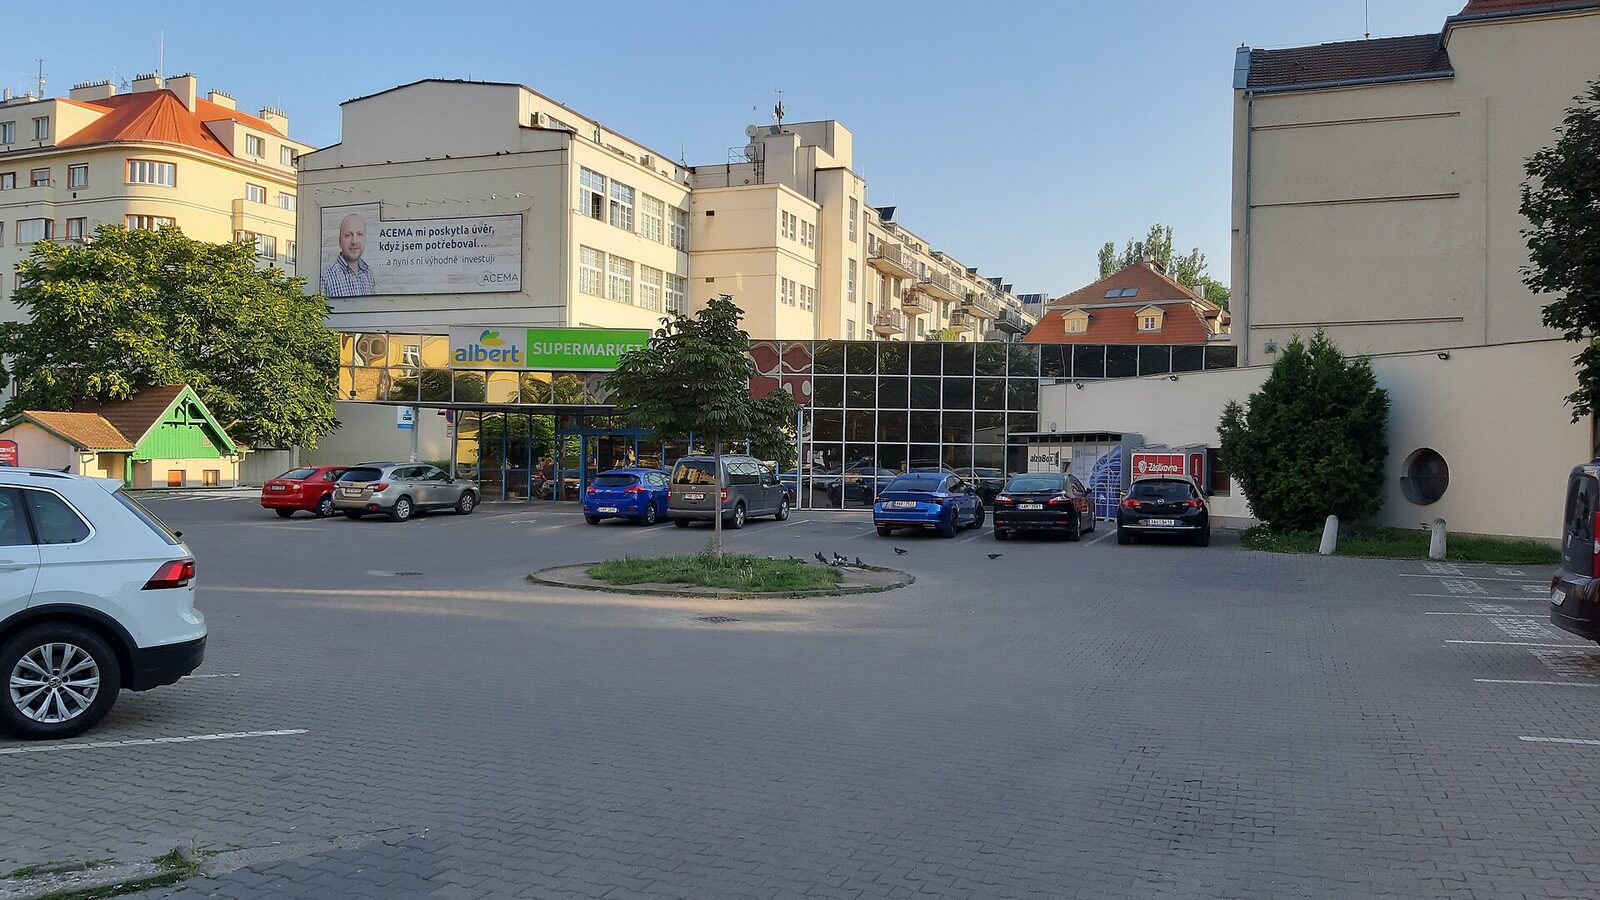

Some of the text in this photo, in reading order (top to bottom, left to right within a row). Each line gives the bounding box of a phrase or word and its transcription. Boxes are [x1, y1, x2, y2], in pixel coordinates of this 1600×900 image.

[379, 223, 495, 238] ACEMA mi poskytla úvěr,
[379, 241, 400, 253] když
[401, 240, 423, 252] jsem
[392, 256, 409, 267] nyní
[410, 258, 415, 266] s
[424, 255, 459, 267] výhodně
[461, 253, 496, 265] investují
[482, 273, 519, 283] ACEMA
[455, 344, 520, 364] albert
[532, 341, 644, 357] SUPERMARKET
